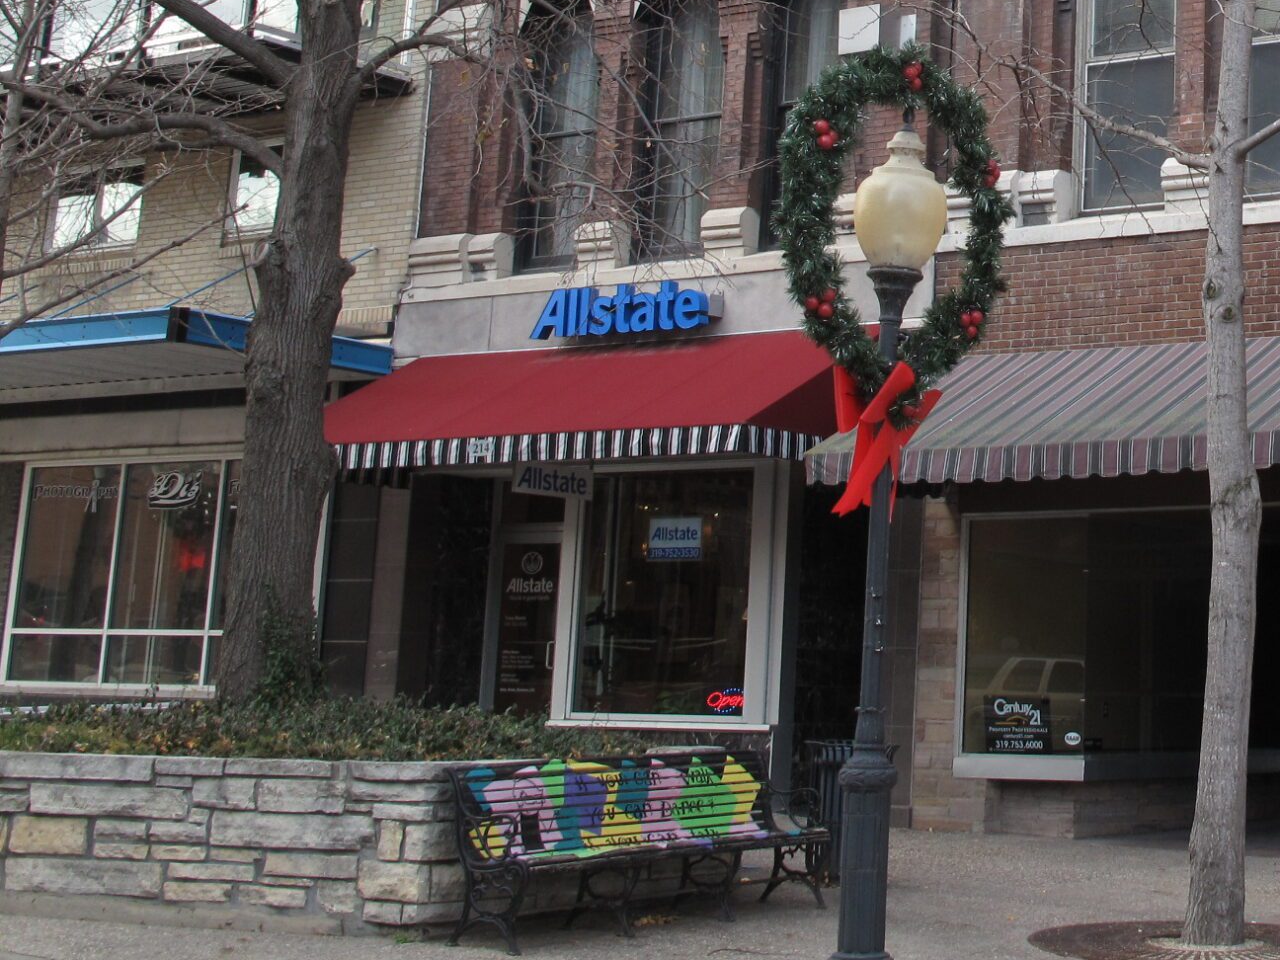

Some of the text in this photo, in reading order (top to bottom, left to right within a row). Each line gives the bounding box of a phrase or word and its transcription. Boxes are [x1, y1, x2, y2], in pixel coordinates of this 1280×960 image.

[529, 279, 709, 340] Allstate
[472, 442, 490, 454] 214
[517, 466, 587, 495] Allstate
[651, 526, 698, 541] Allstate
[651, 547, 699, 559] 319-752-3530
[506, 577, 553, 593] Allstate
[707, 691, 745, 711] Open
[994, 698, 1032, 716] Century
[1029, 709, 1041, 726] 21
[995, 740, 1043, 749] 319.753.6000
